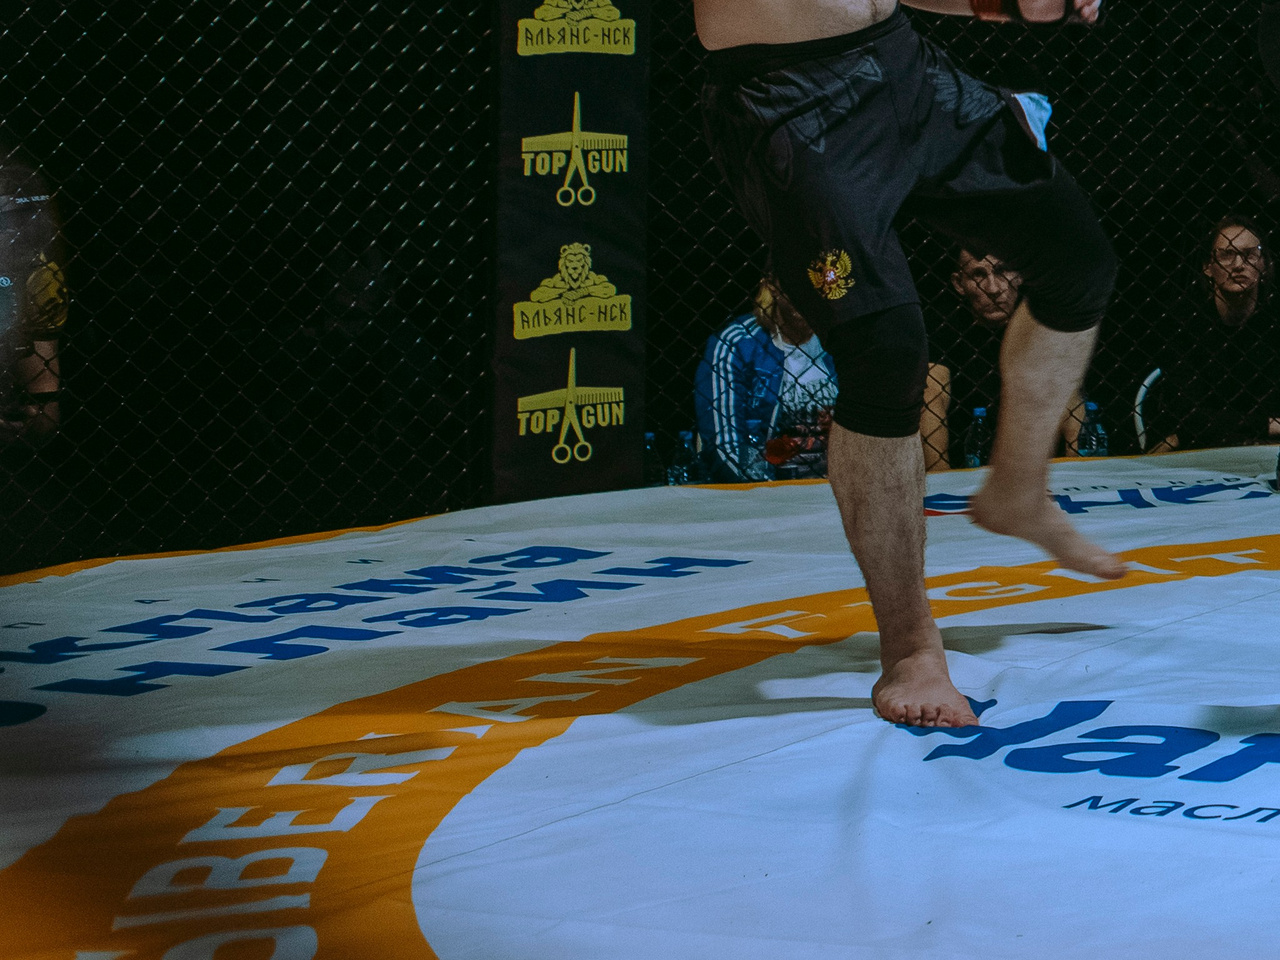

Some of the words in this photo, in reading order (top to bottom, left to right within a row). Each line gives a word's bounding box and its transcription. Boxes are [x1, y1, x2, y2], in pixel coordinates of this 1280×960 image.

[524, 26, 632, 47] АЛЬЯНС-НСК
[522, 151, 566, 176] TOP
[587, 150, 628, 174] GUN
[520, 302, 628, 330] АЛЬЯНС-НСК
[517, 410, 560, 436] TOP
[582, 403, 625, 429] GUN
[0, 545, 615, 674] клама
